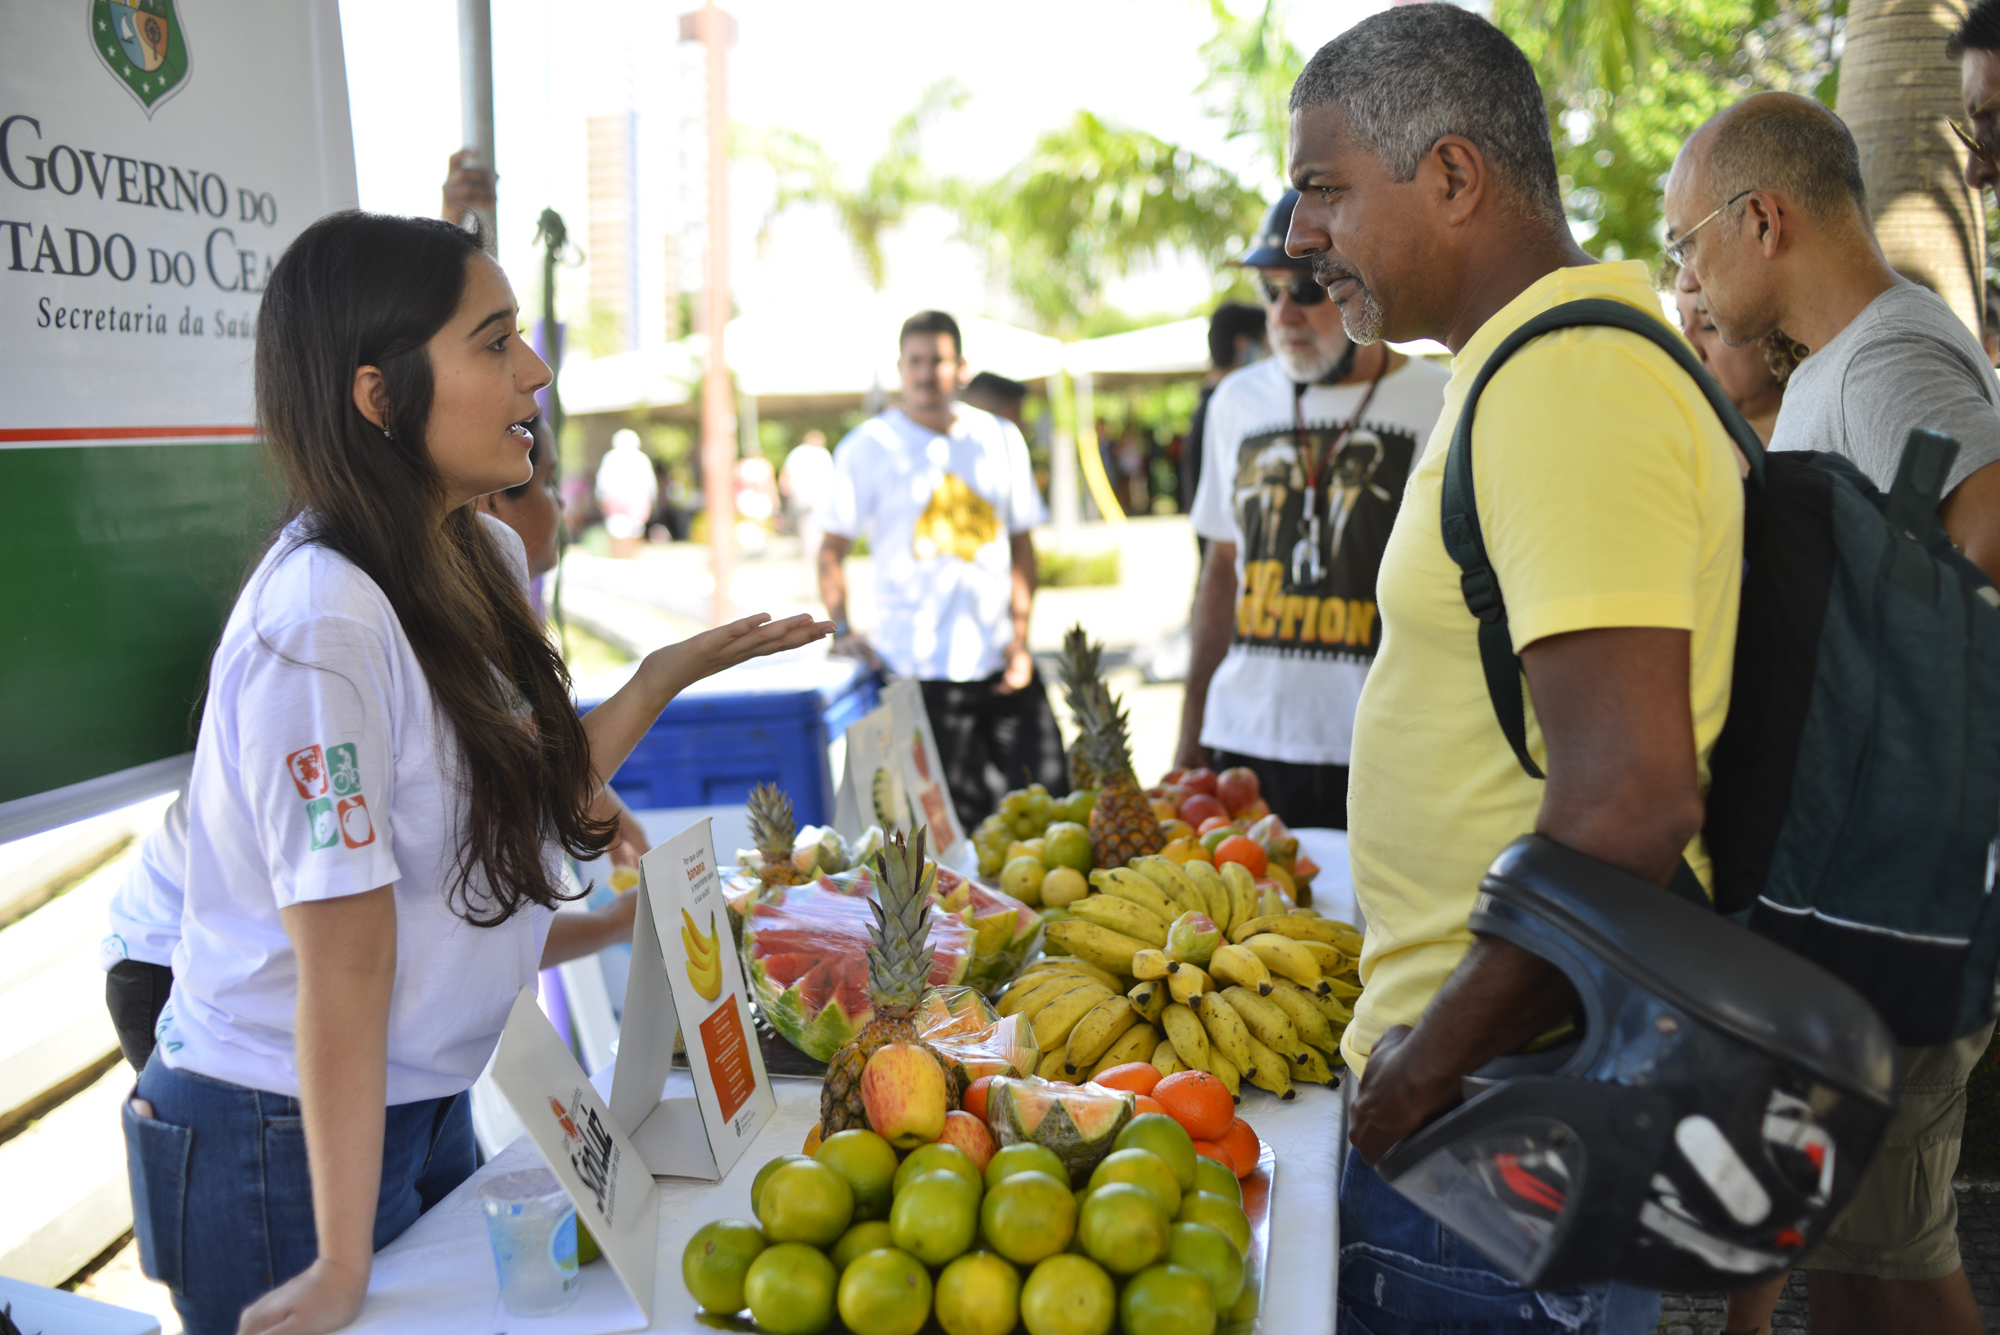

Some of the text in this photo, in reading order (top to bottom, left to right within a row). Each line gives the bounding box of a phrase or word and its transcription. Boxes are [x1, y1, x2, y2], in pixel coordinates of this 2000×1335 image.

[0, 115, 277, 227] GOVERNO DO
[0, 220, 272, 294] TADO DO CEA
[37, 297, 257, 340] Secretaria da Saú
[686, 861, 706, 881] banana
